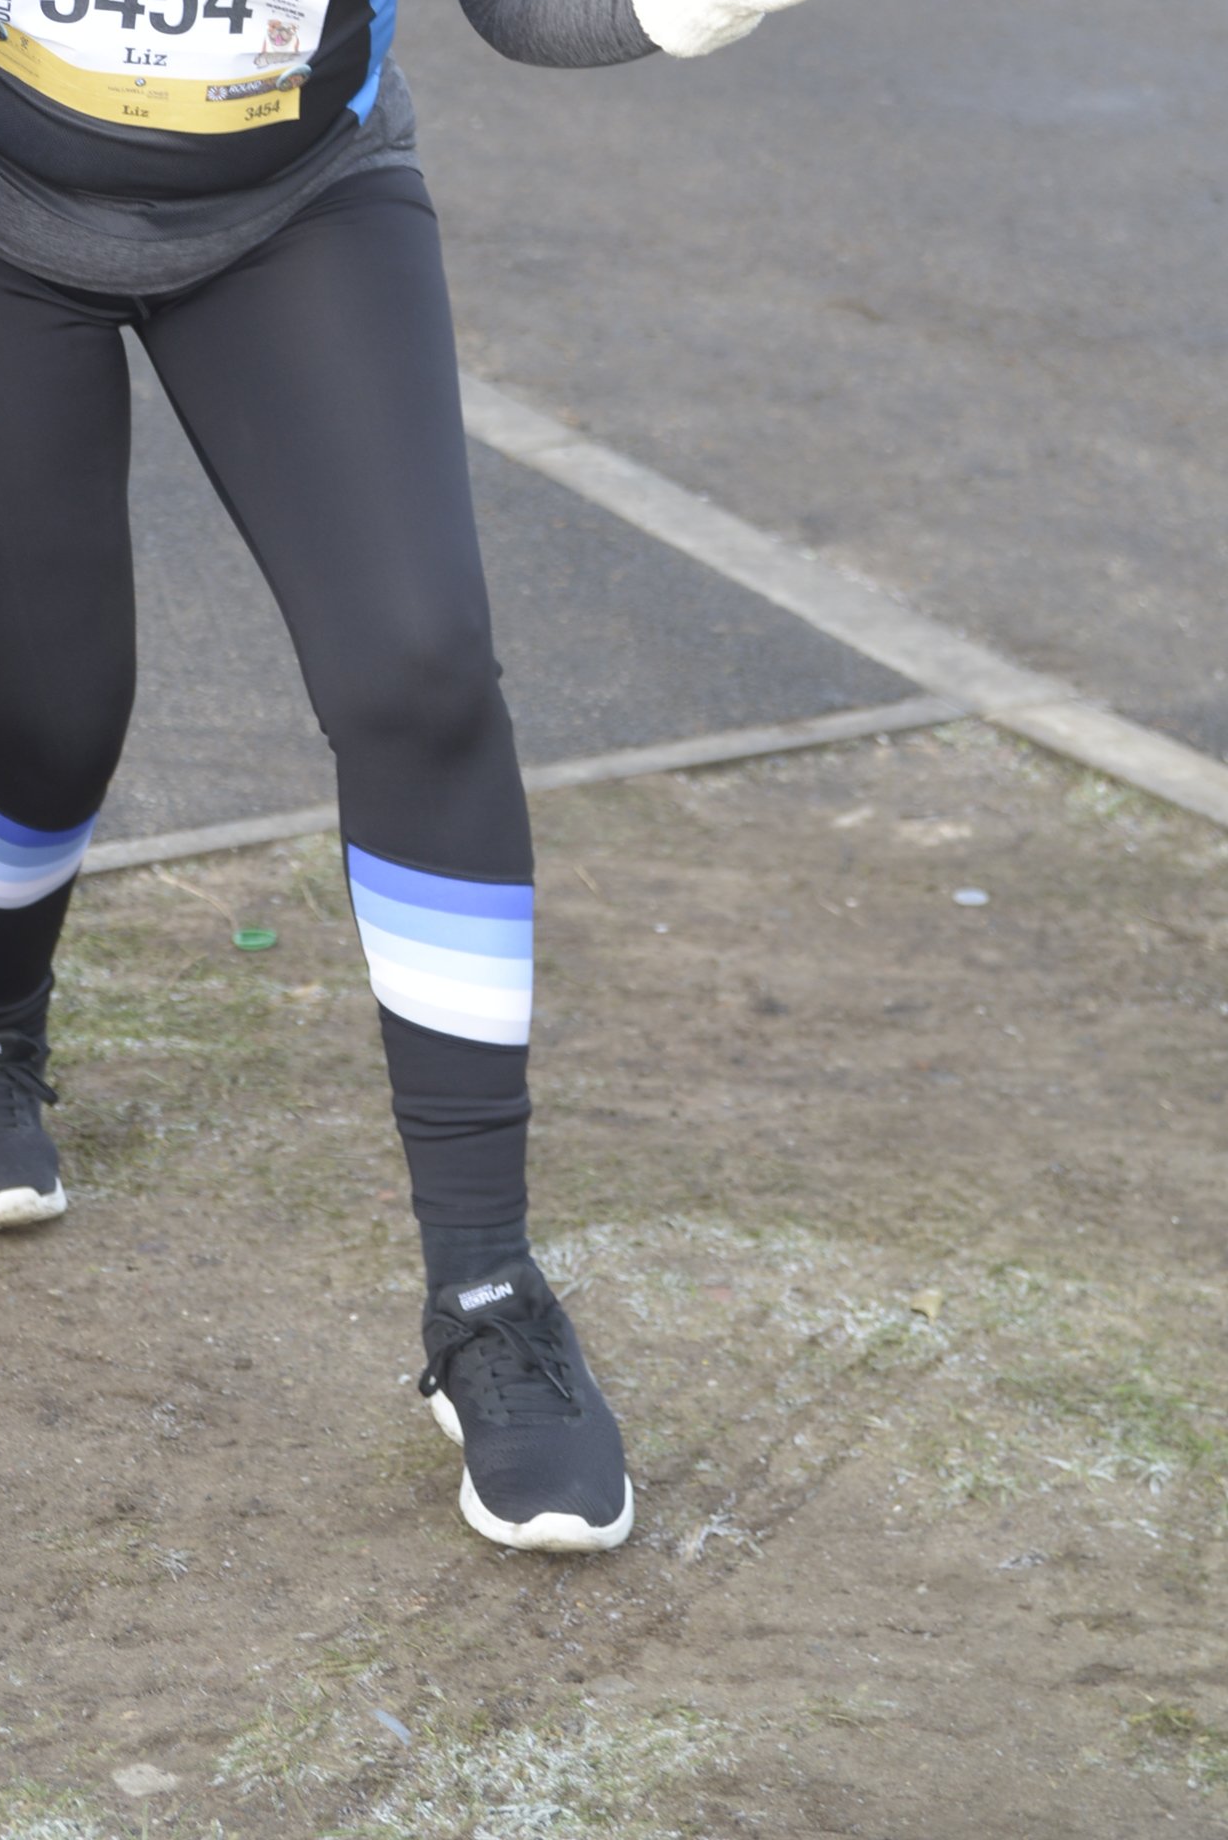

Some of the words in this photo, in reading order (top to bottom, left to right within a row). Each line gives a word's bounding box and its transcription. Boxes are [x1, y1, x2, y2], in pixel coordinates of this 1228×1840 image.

[123, 46, 168, 67] Liz
[122, 104, 150, 118] Liz
[244, 99, 281, 121] 3454
